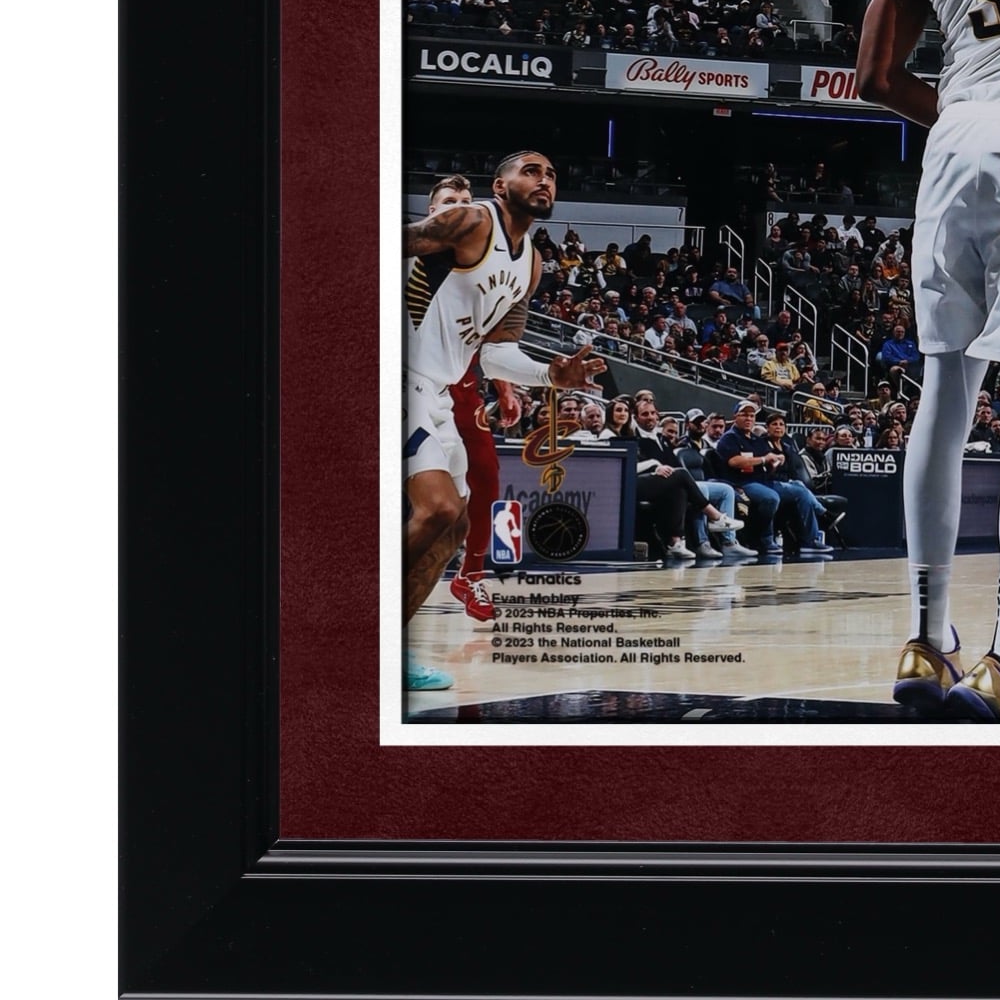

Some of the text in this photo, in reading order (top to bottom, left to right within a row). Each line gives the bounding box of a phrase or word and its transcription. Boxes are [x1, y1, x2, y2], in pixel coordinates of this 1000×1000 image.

[626, 57, 749, 90] Bally SPORTS
[836, 452, 896, 464] INDIANA
[850, 463, 897, 474] BOLD
